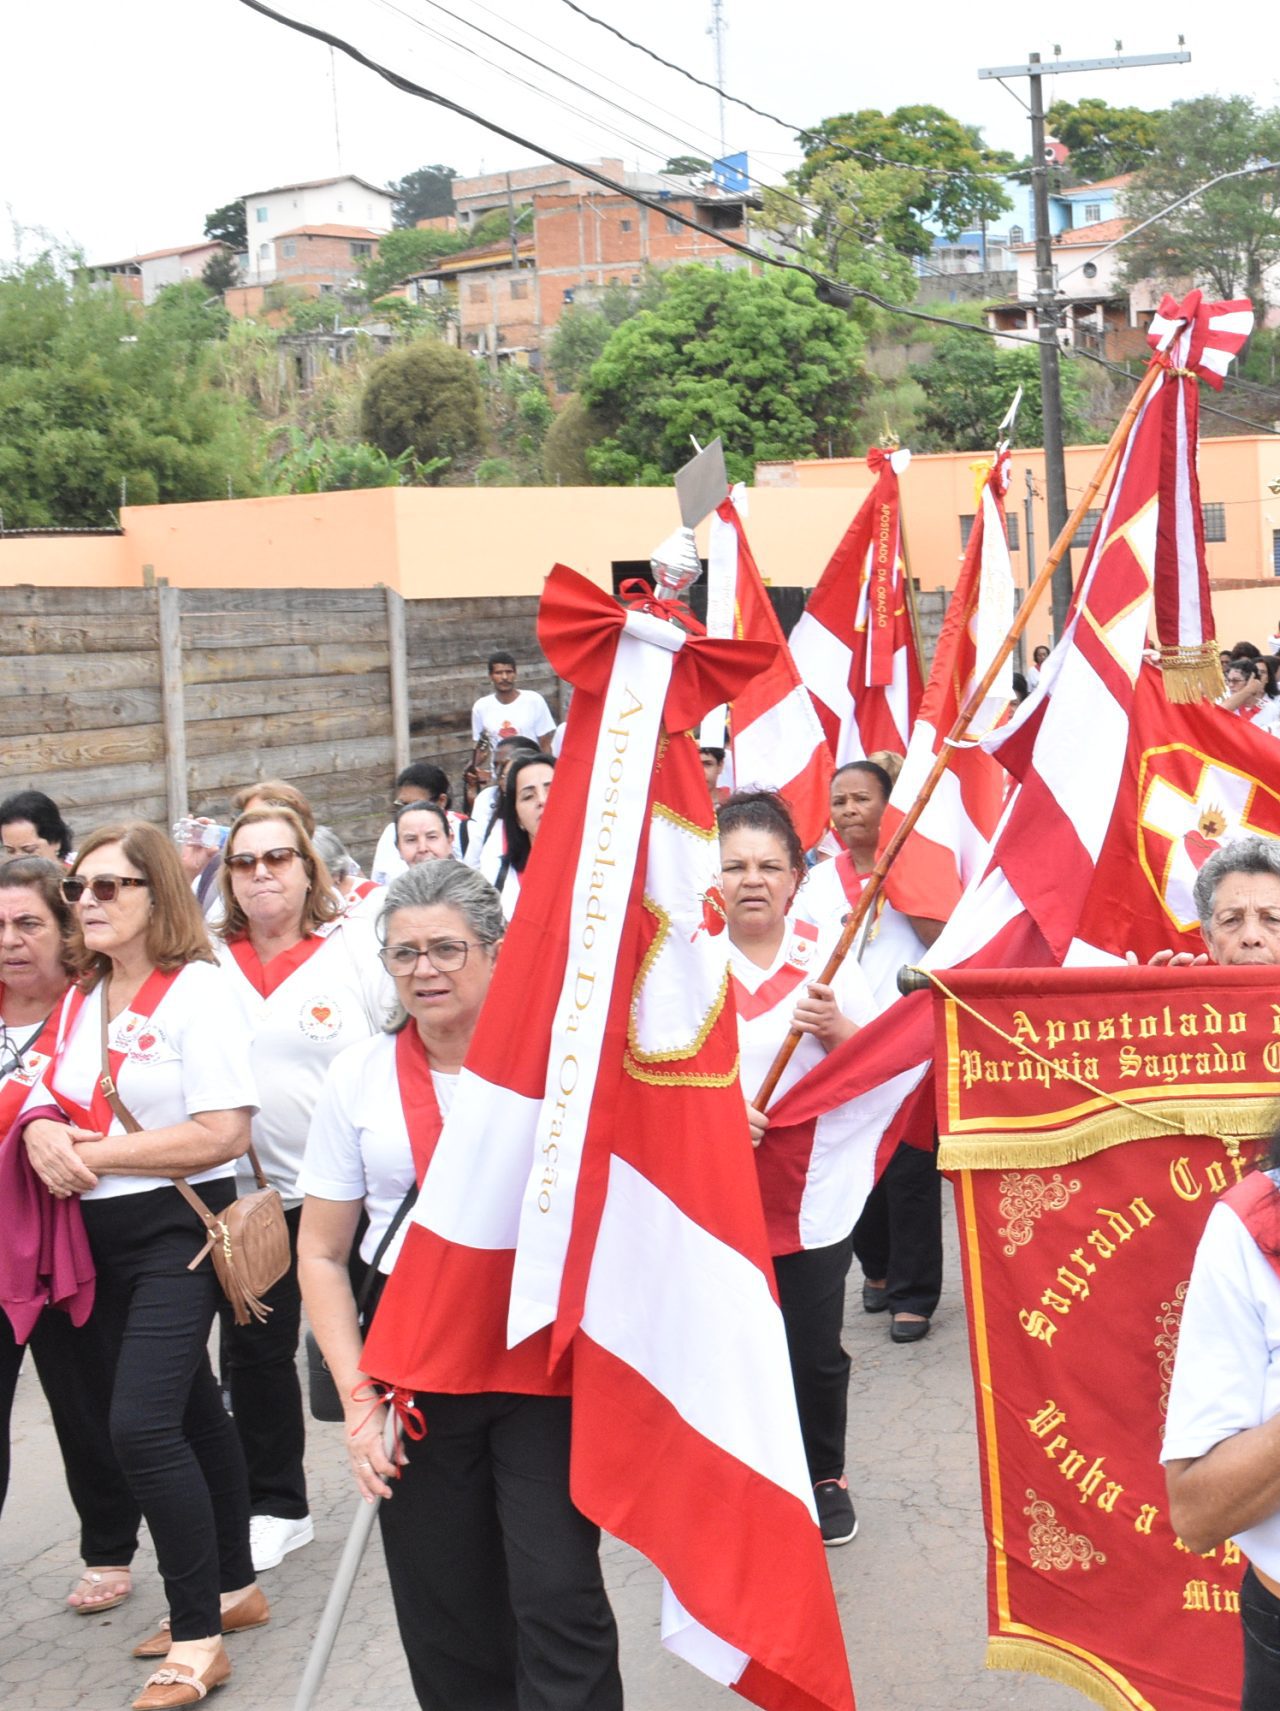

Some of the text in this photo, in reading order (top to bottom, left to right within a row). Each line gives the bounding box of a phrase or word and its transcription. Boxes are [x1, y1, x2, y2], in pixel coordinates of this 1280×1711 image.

[879, 503, 891, 564] APOSTOLADO
[877, 568, 887, 582] DA
[537, 681, 644, 1214] Apostolado Da Oração
[1009, 1003, 1247, 1049] Apostolado
[1119, 1043, 1247, 1083] Sagrado
[1018, 1196, 1156, 1348] Sagrado
[1026, 1399, 1159, 1535] Venha a
